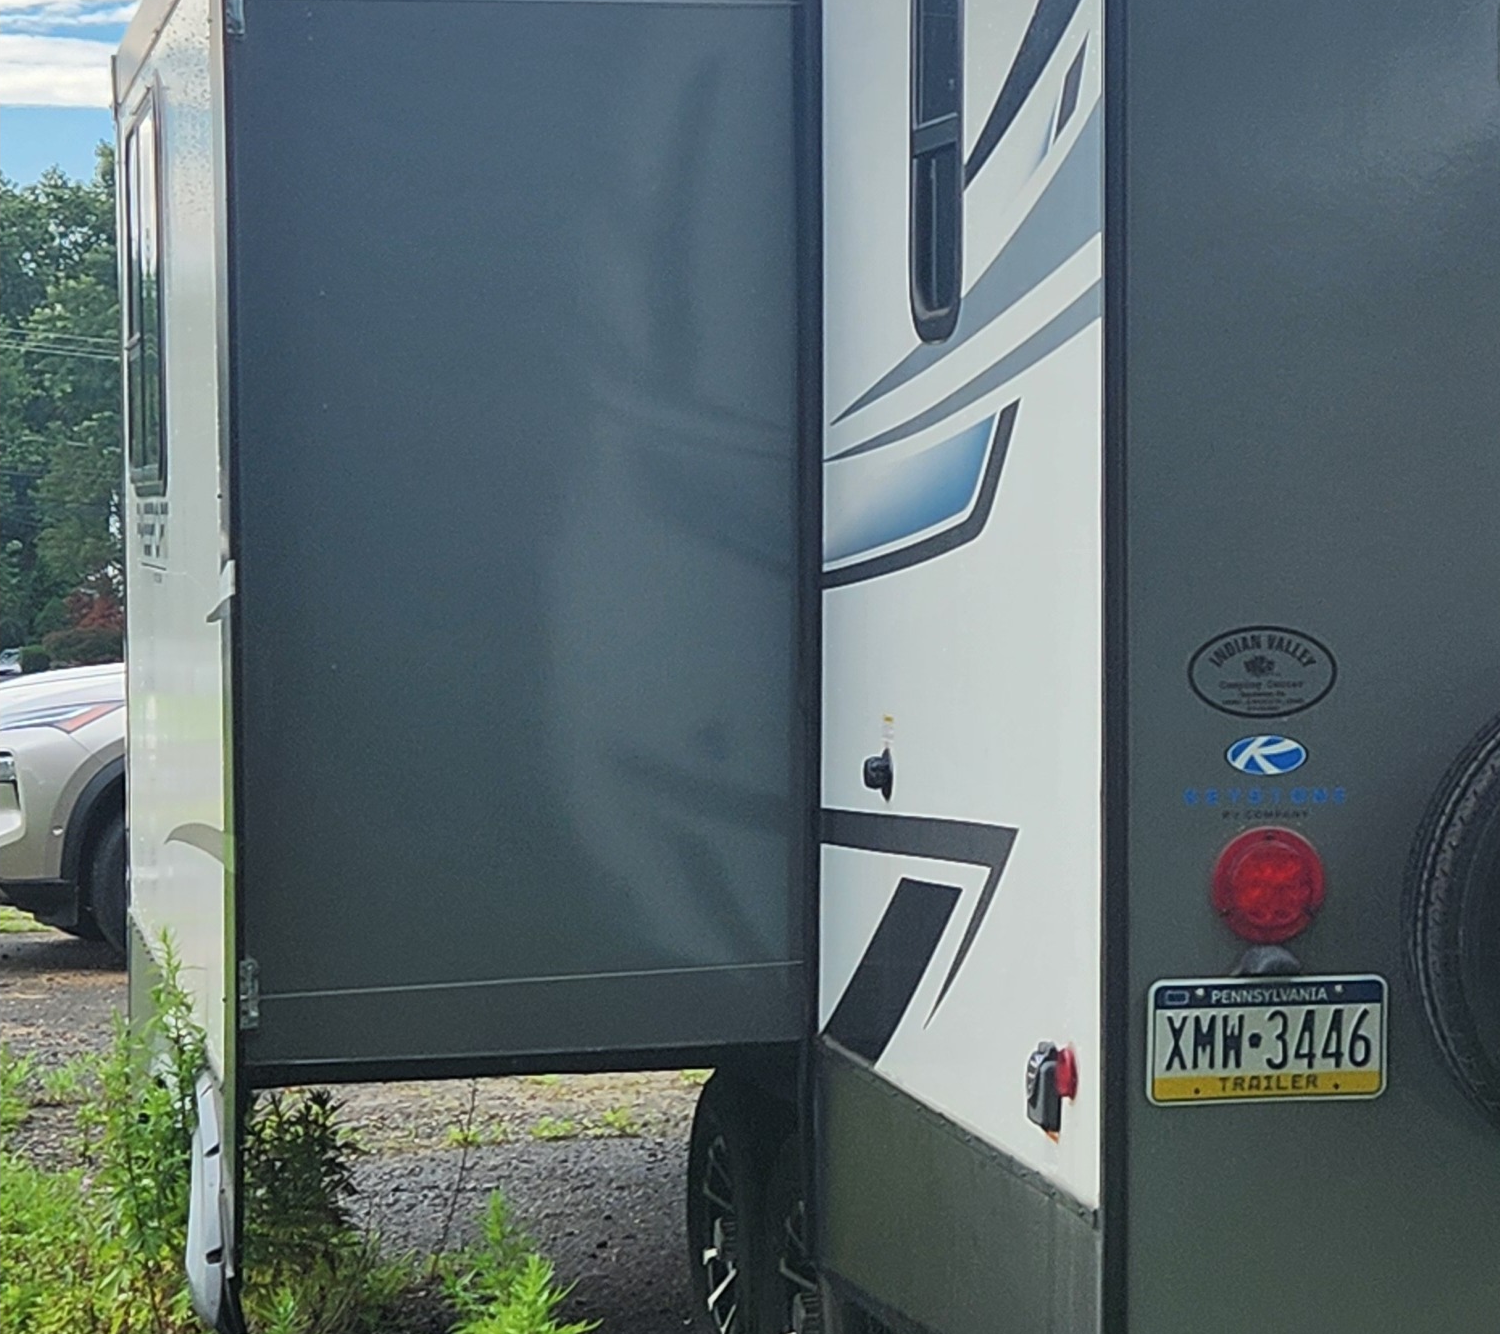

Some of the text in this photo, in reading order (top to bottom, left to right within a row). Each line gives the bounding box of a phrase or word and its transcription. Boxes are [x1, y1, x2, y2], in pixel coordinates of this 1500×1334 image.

[1208, 634, 1317, 668] INDIAN VALLEY
[1211, 986, 1329, 1005] PENNSYLVANIA
[1218, 1074, 1319, 1092] TRAILER
